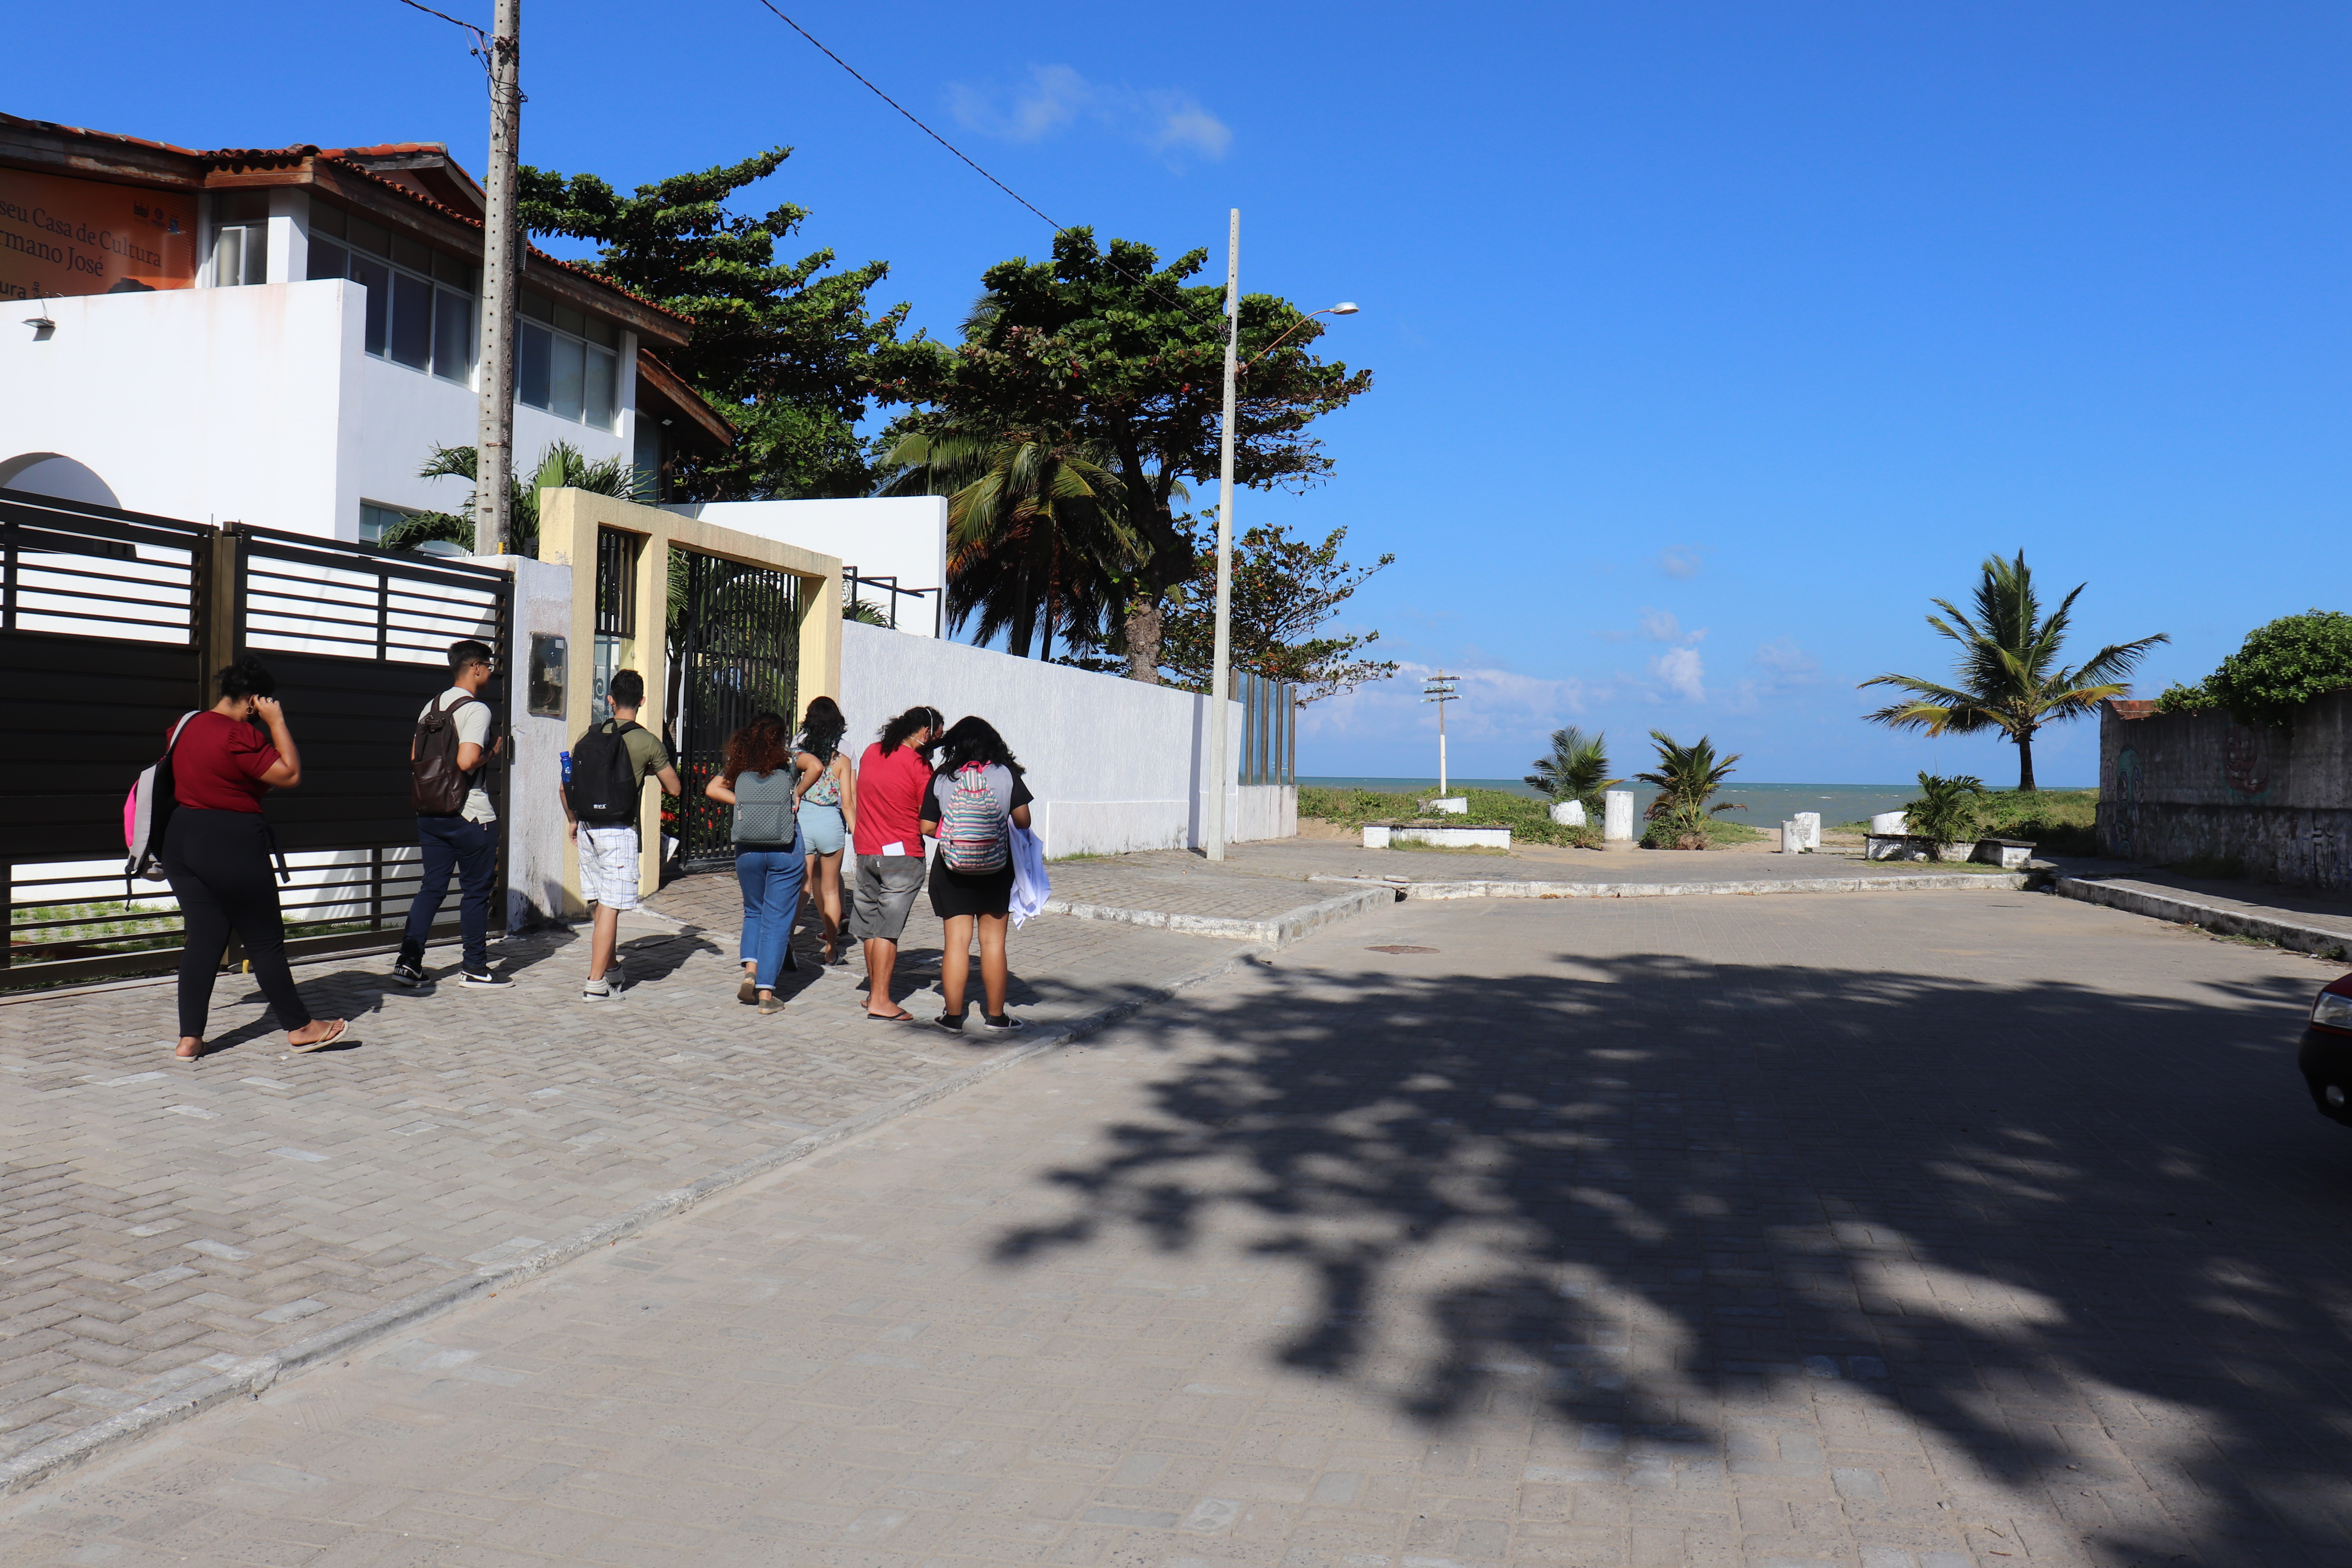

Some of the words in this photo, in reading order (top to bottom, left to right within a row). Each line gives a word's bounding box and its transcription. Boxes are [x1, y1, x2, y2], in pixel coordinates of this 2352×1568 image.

[33, 208, 73, 238] Casa
[76, 223, 96, 246] de
[100, 231, 162, 268] Cultura
[66, 246, 103, 277] José
